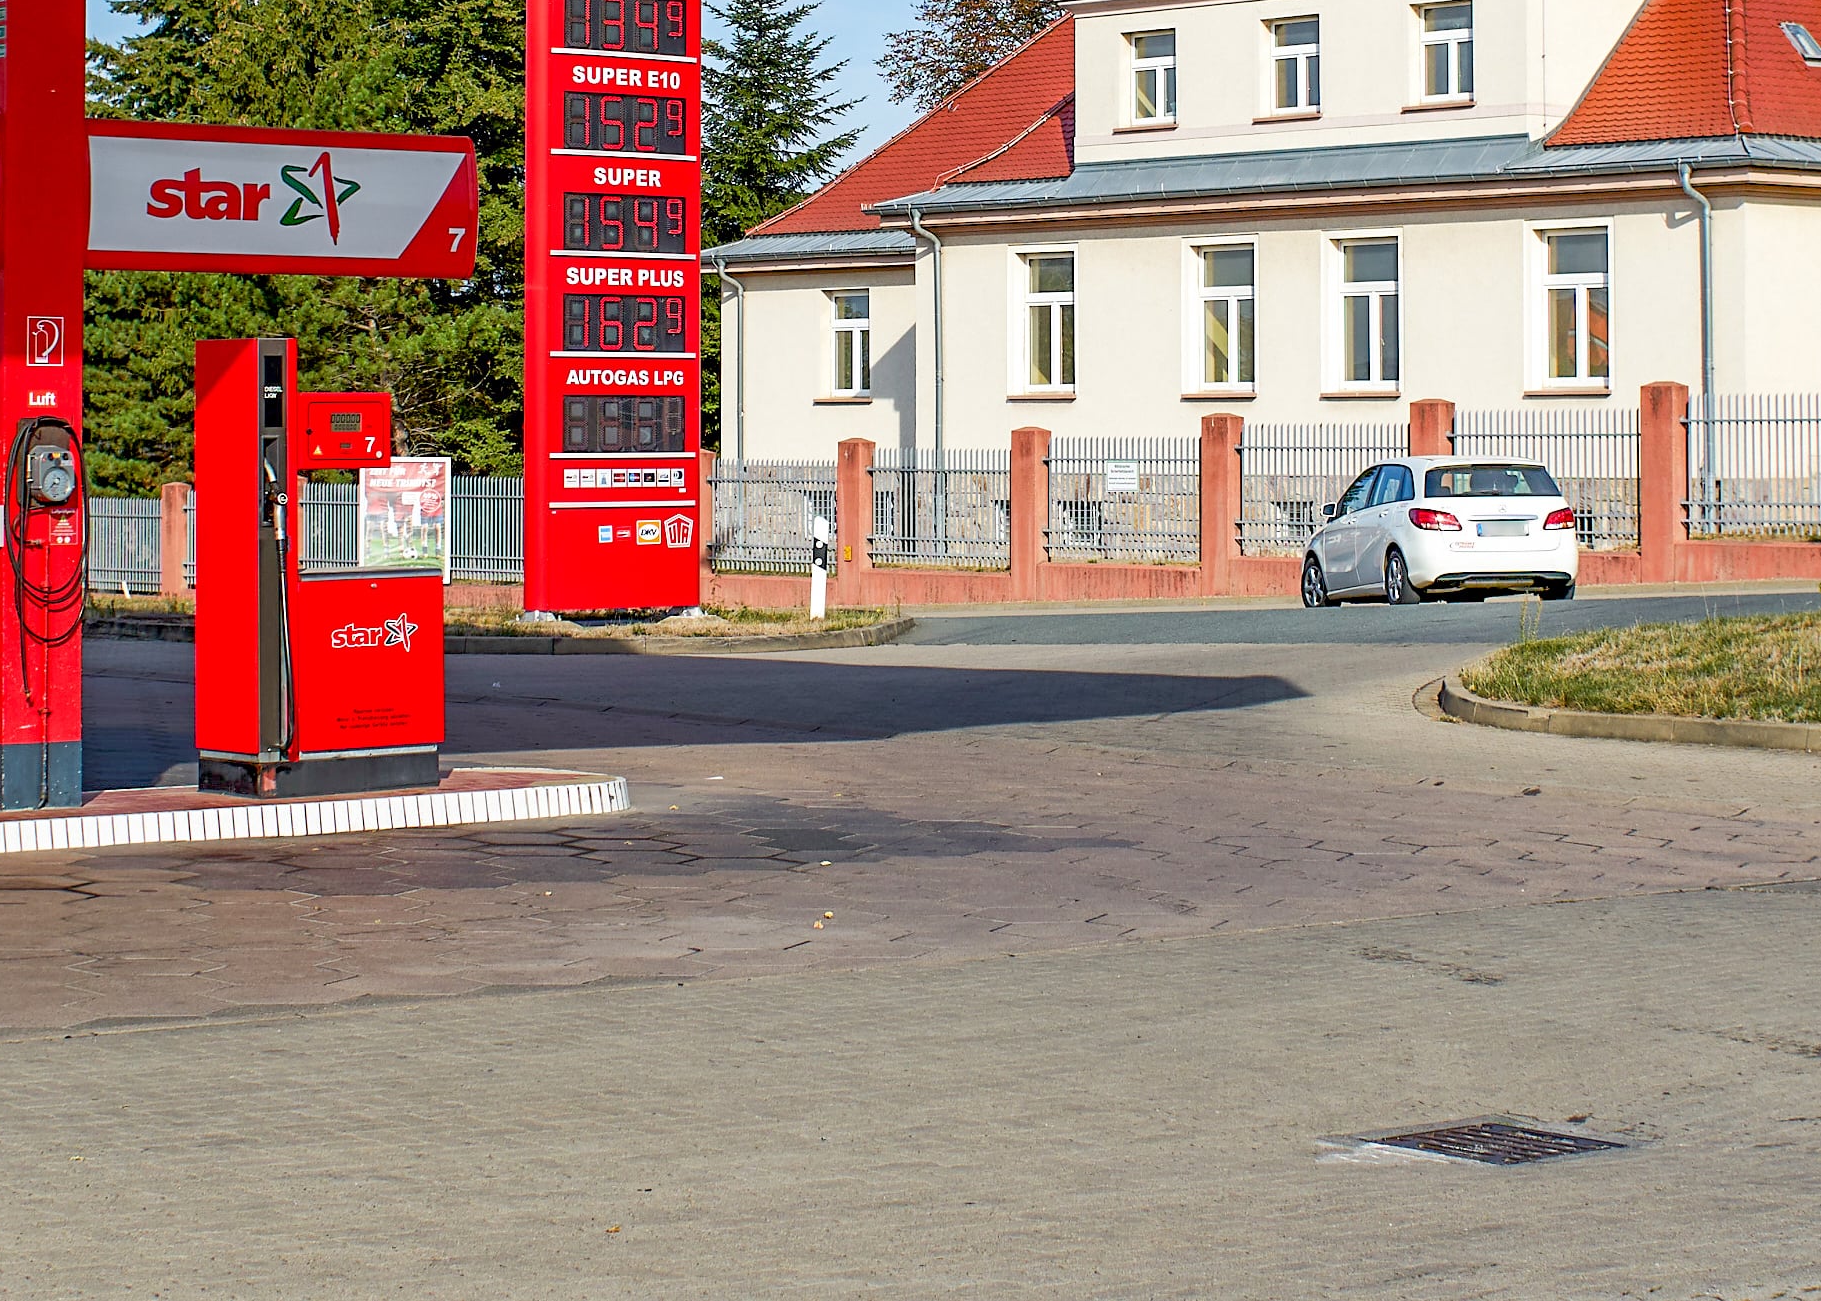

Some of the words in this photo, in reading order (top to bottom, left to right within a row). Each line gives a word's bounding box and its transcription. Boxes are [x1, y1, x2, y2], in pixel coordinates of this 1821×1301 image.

[571, 65, 643, 88] SUPER
[647, 70, 681, 90] E10
[593, 167, 662, 188] SUPER
[146, 167, 271, 222] star
[448, 227, 467, 253] 7
[566, 266, 634, 287] SUPER
[637, 269, 685, 288] PLUS
[566, 369, 650, 386] AUTOGAS
[653, 370, 685, 386] LPG
[28, 391, 57, 406] Luft
[364, 436, 376, 453] 7
[640, 528, 658, 536] DKV
[331, 622, 383, 649] star
